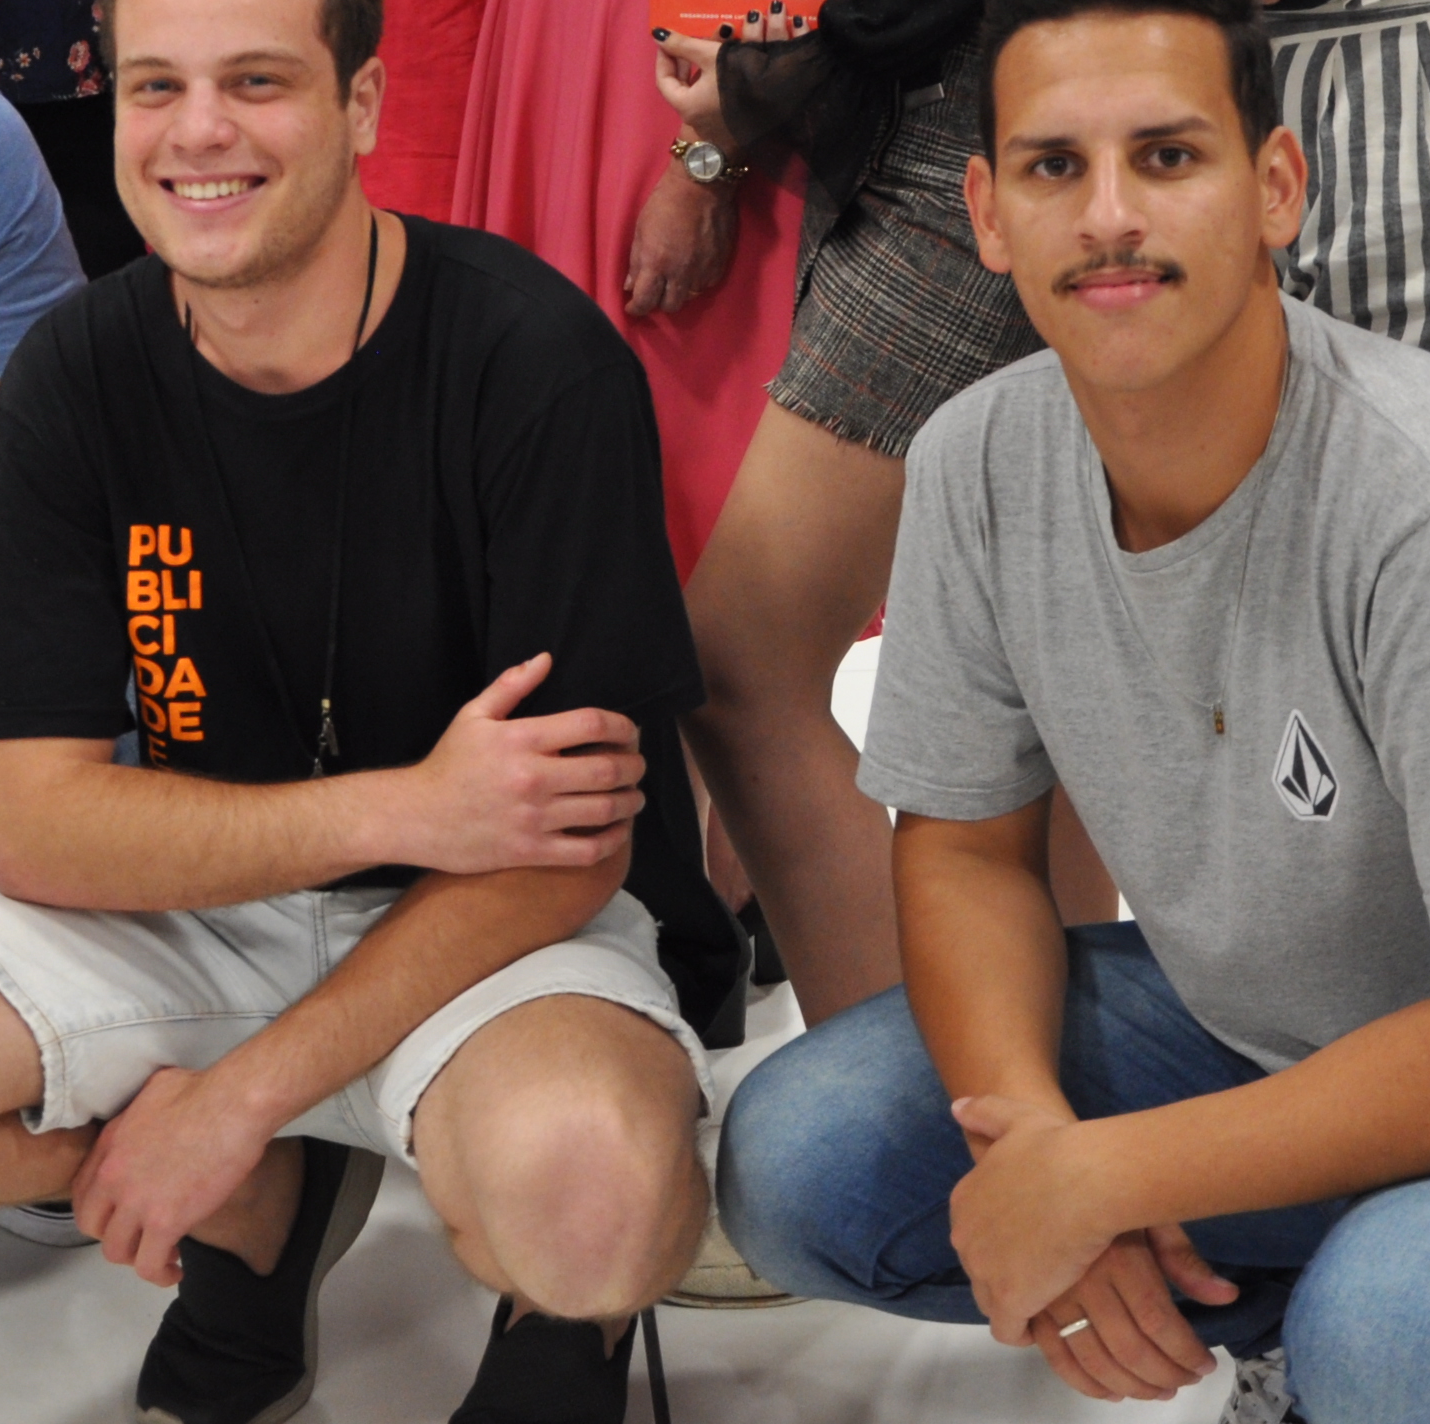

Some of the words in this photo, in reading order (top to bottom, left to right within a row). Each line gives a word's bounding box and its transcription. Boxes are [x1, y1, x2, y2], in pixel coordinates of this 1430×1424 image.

[128, 524, 193, 566] PU
[127, 569, 202, 611] BLI
[127, 614, 175, 655] CI
[133, 654, 207, 698] DA
[138, 694, 204, 742] DE
